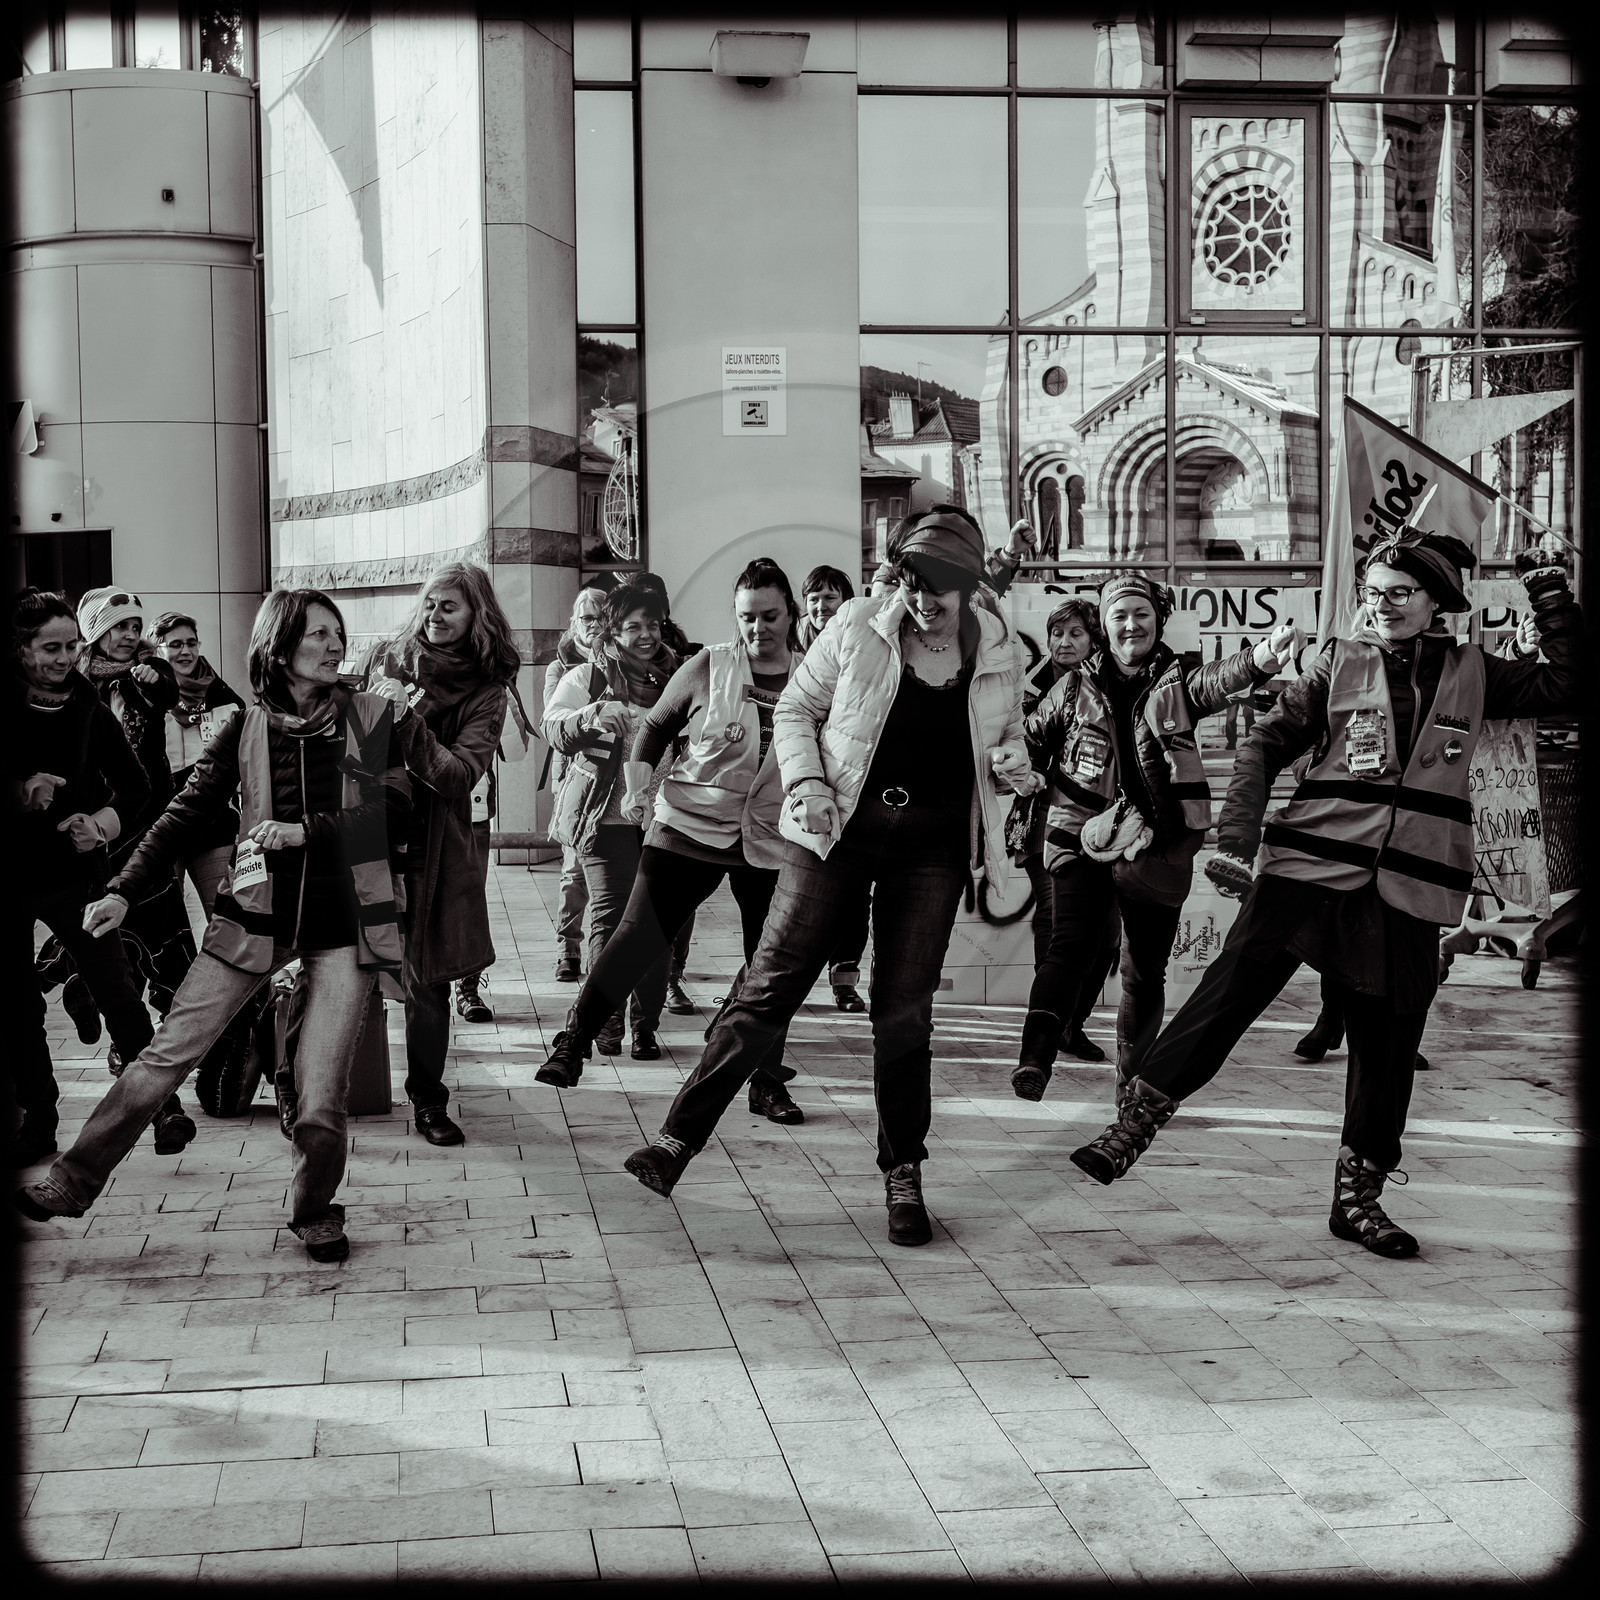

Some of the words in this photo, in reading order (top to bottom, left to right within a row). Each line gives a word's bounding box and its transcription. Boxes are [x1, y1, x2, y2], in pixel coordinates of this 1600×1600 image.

[725, 354, 743, 365] JEUX
[744, 354, 780, 365] INTERDITS
[1434, 712, 1470, 732] Solidaires
